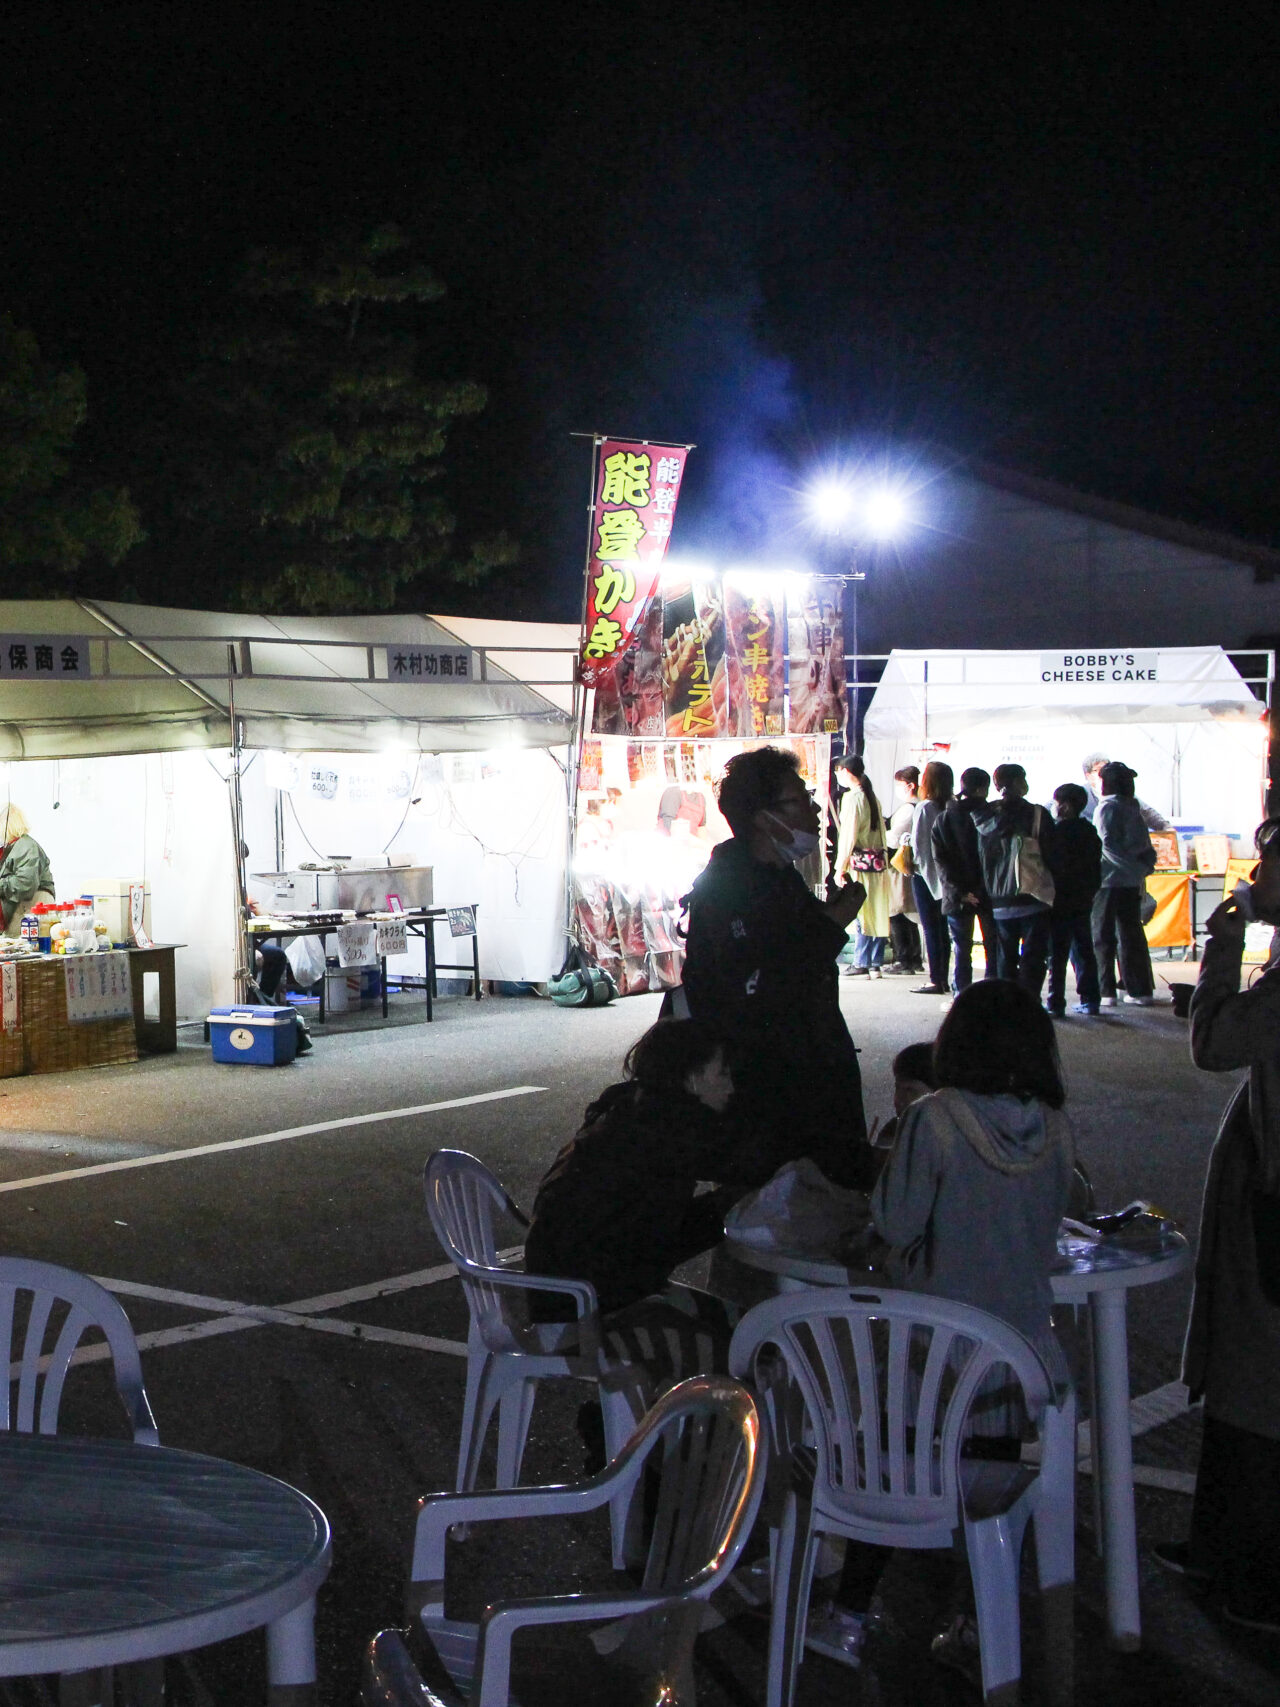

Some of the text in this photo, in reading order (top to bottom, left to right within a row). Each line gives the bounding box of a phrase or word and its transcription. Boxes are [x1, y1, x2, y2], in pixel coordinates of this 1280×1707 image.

[648, 457, 680, 566] 能登半
[583, 451, 652, 660] 能登かき
[392, 651, 469, 678] 木村功商店
[1063, 654, 1135, 667] BOBBY'S
[1041, 669, 1157, 683] CHEESE CAKE
[380, 940, 406, 951] 600円
